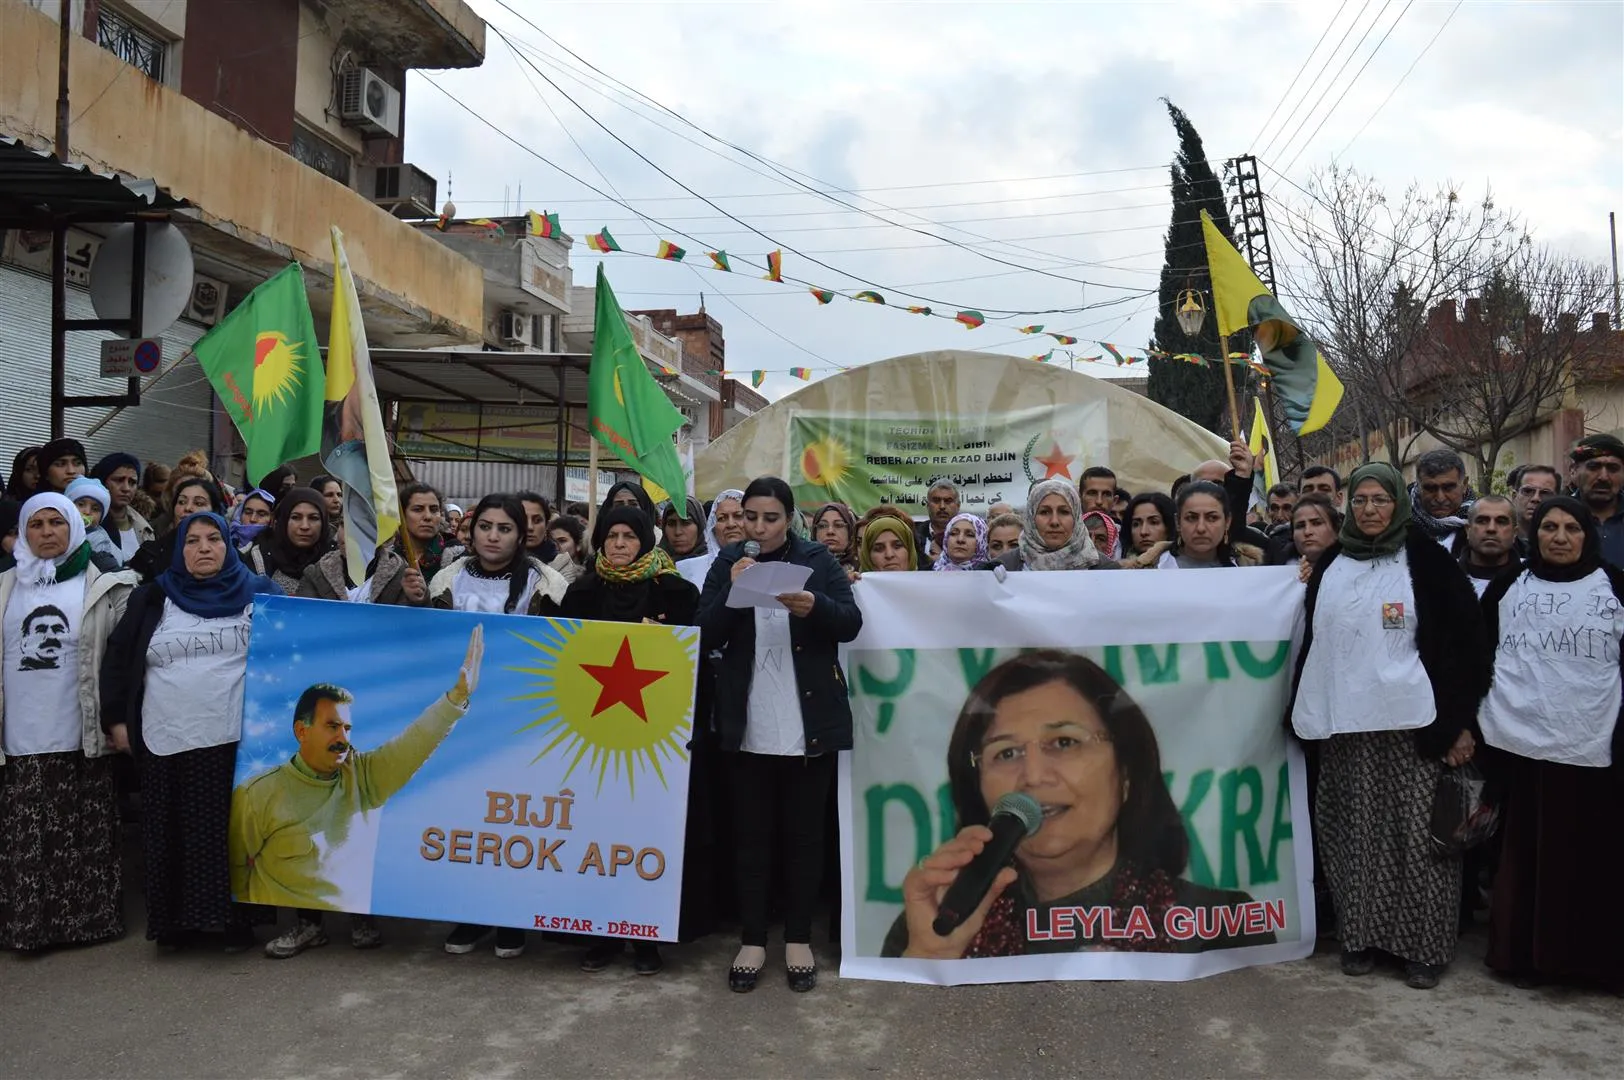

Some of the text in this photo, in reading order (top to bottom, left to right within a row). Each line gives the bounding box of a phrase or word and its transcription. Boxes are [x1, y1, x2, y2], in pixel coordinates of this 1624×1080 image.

[905, 456, 929, 465] APO
[932, 456, 948, 464] RE
[950, 454, 981, 464] AZAD
[483, 787, 576, 831] BIJÎ
[419, 826, 667, 881] SEROK APO
[534, 914, 593, 932] K.STAR
[607, 920, 660, 938] DÊRIK
[1026, 899, 1287, 941] LEYLA GUVEN
